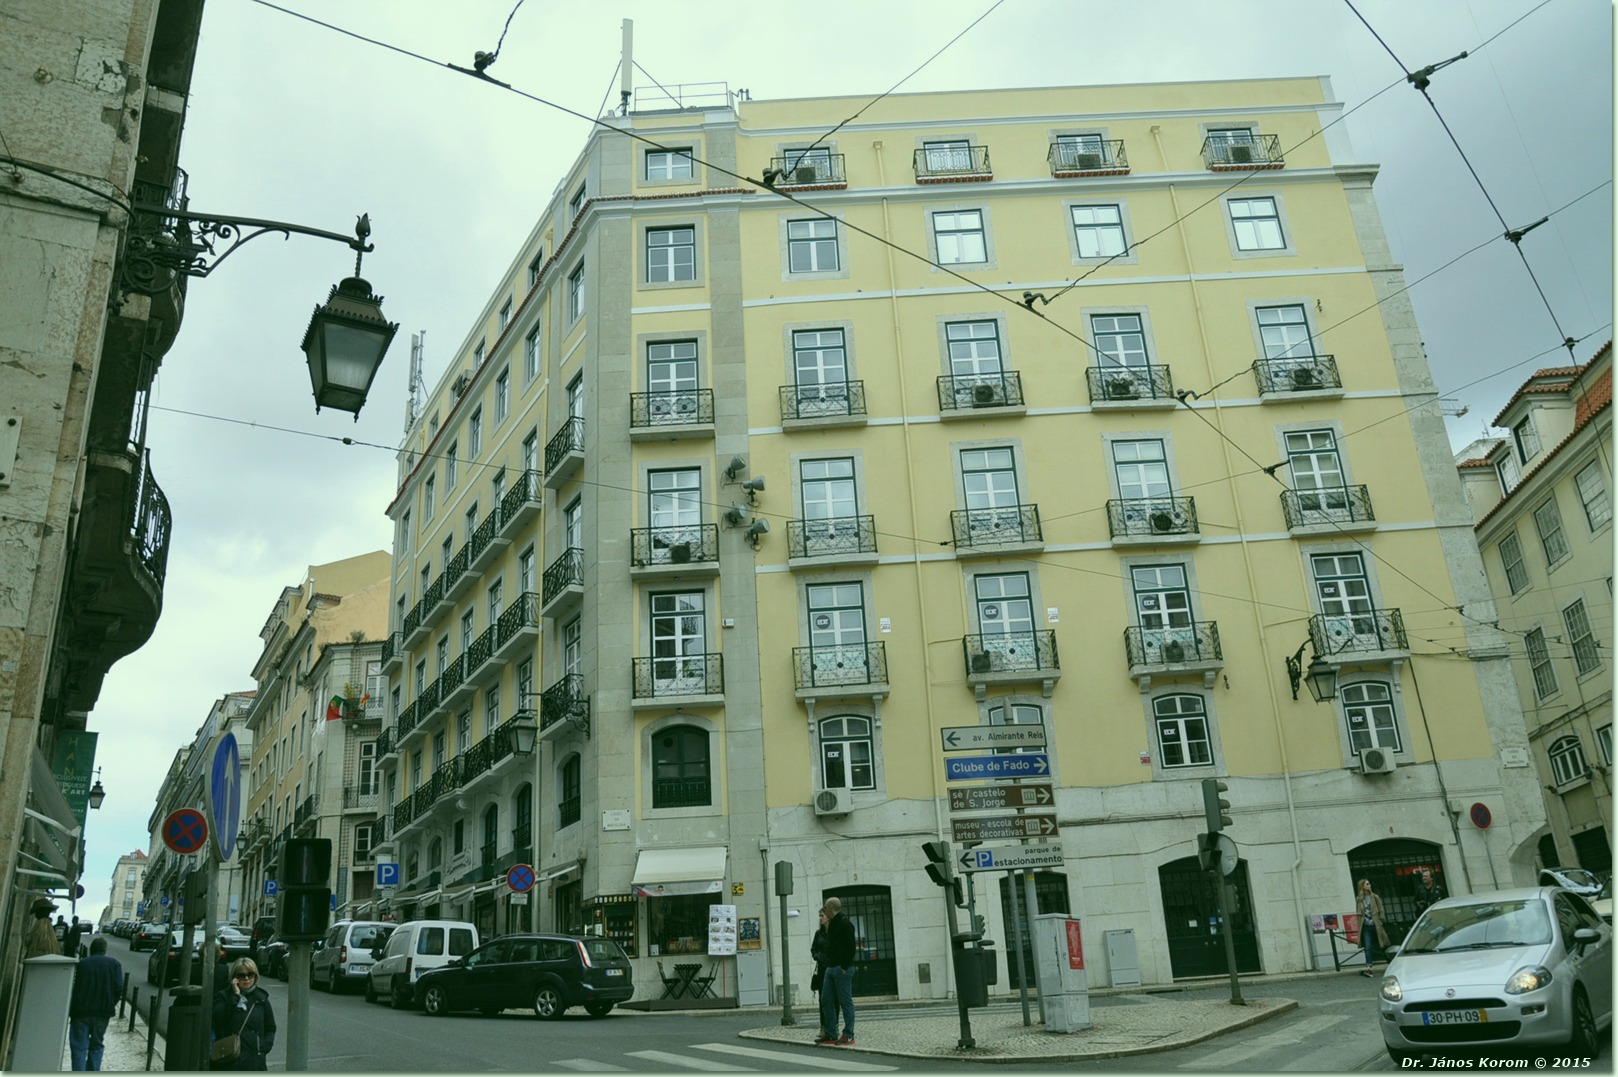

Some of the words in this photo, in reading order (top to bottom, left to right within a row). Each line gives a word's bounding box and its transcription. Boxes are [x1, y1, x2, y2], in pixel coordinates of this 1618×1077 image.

[972, 733, 984, 742] av.
[988, 731, 1025, 740] Almirante
[1027, 730, 1044, 739] Reis
[952, 762, 984, 773] Clube
[987, 761, 1000, 771] de
[1003, 760, 1030, 770] Fado
[973, 788, 1006, 797] castelo
[953, 800, 965, 808] de
[969, 799, 979, 807] S.
[982, 798, 1006, 809] Jorge
[987, 819, 1012, 829] escola
[1015, 818, 1025, 826] de
[956, 830, 977, 839] artes
[979, 828, 1024, 838] decorativas
[1024, 847, 1049, 855] parque
[978, 852, 990, 867] P
[994, 855, 1063, 867] estacionamento
[381, 865, 395, 883] P
[266, 881, 276, 893] P
